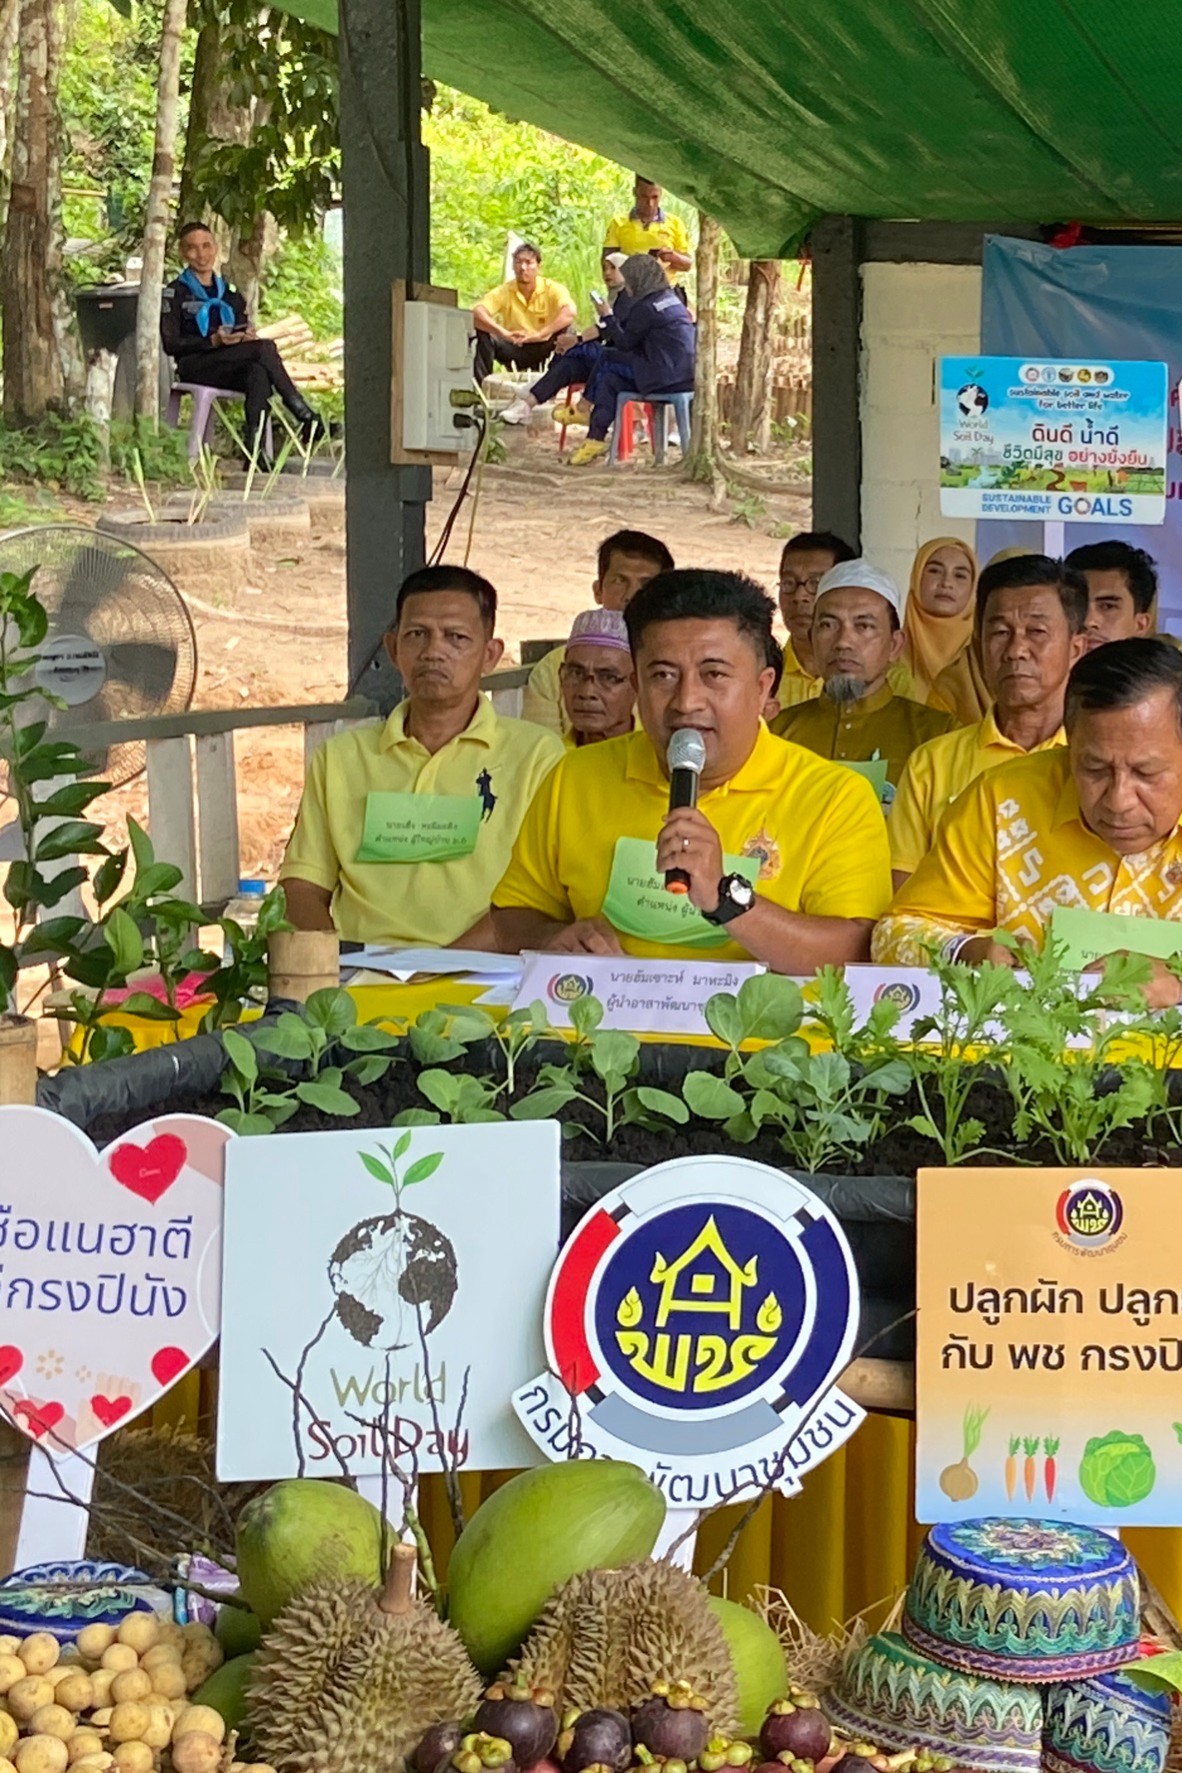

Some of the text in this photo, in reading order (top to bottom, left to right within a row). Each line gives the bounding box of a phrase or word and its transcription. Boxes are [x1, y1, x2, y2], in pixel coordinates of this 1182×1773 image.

[1032, 418, 1120, 445] ดินดี น้ำดี
[982, 493, 1133, 517] SUSTAINABLE GOALS
[982, 504, 1051, 514] DEVELOPMENT
[950, 1278, 1084, 1326] ปลูกผัก
[941, 1333, 994, 1370] กับ
[1008, 1342, 1066, 1371] พช
[329, 1360, 447, 1407] World
[306, 1414, 470, 1468] Soil Day
